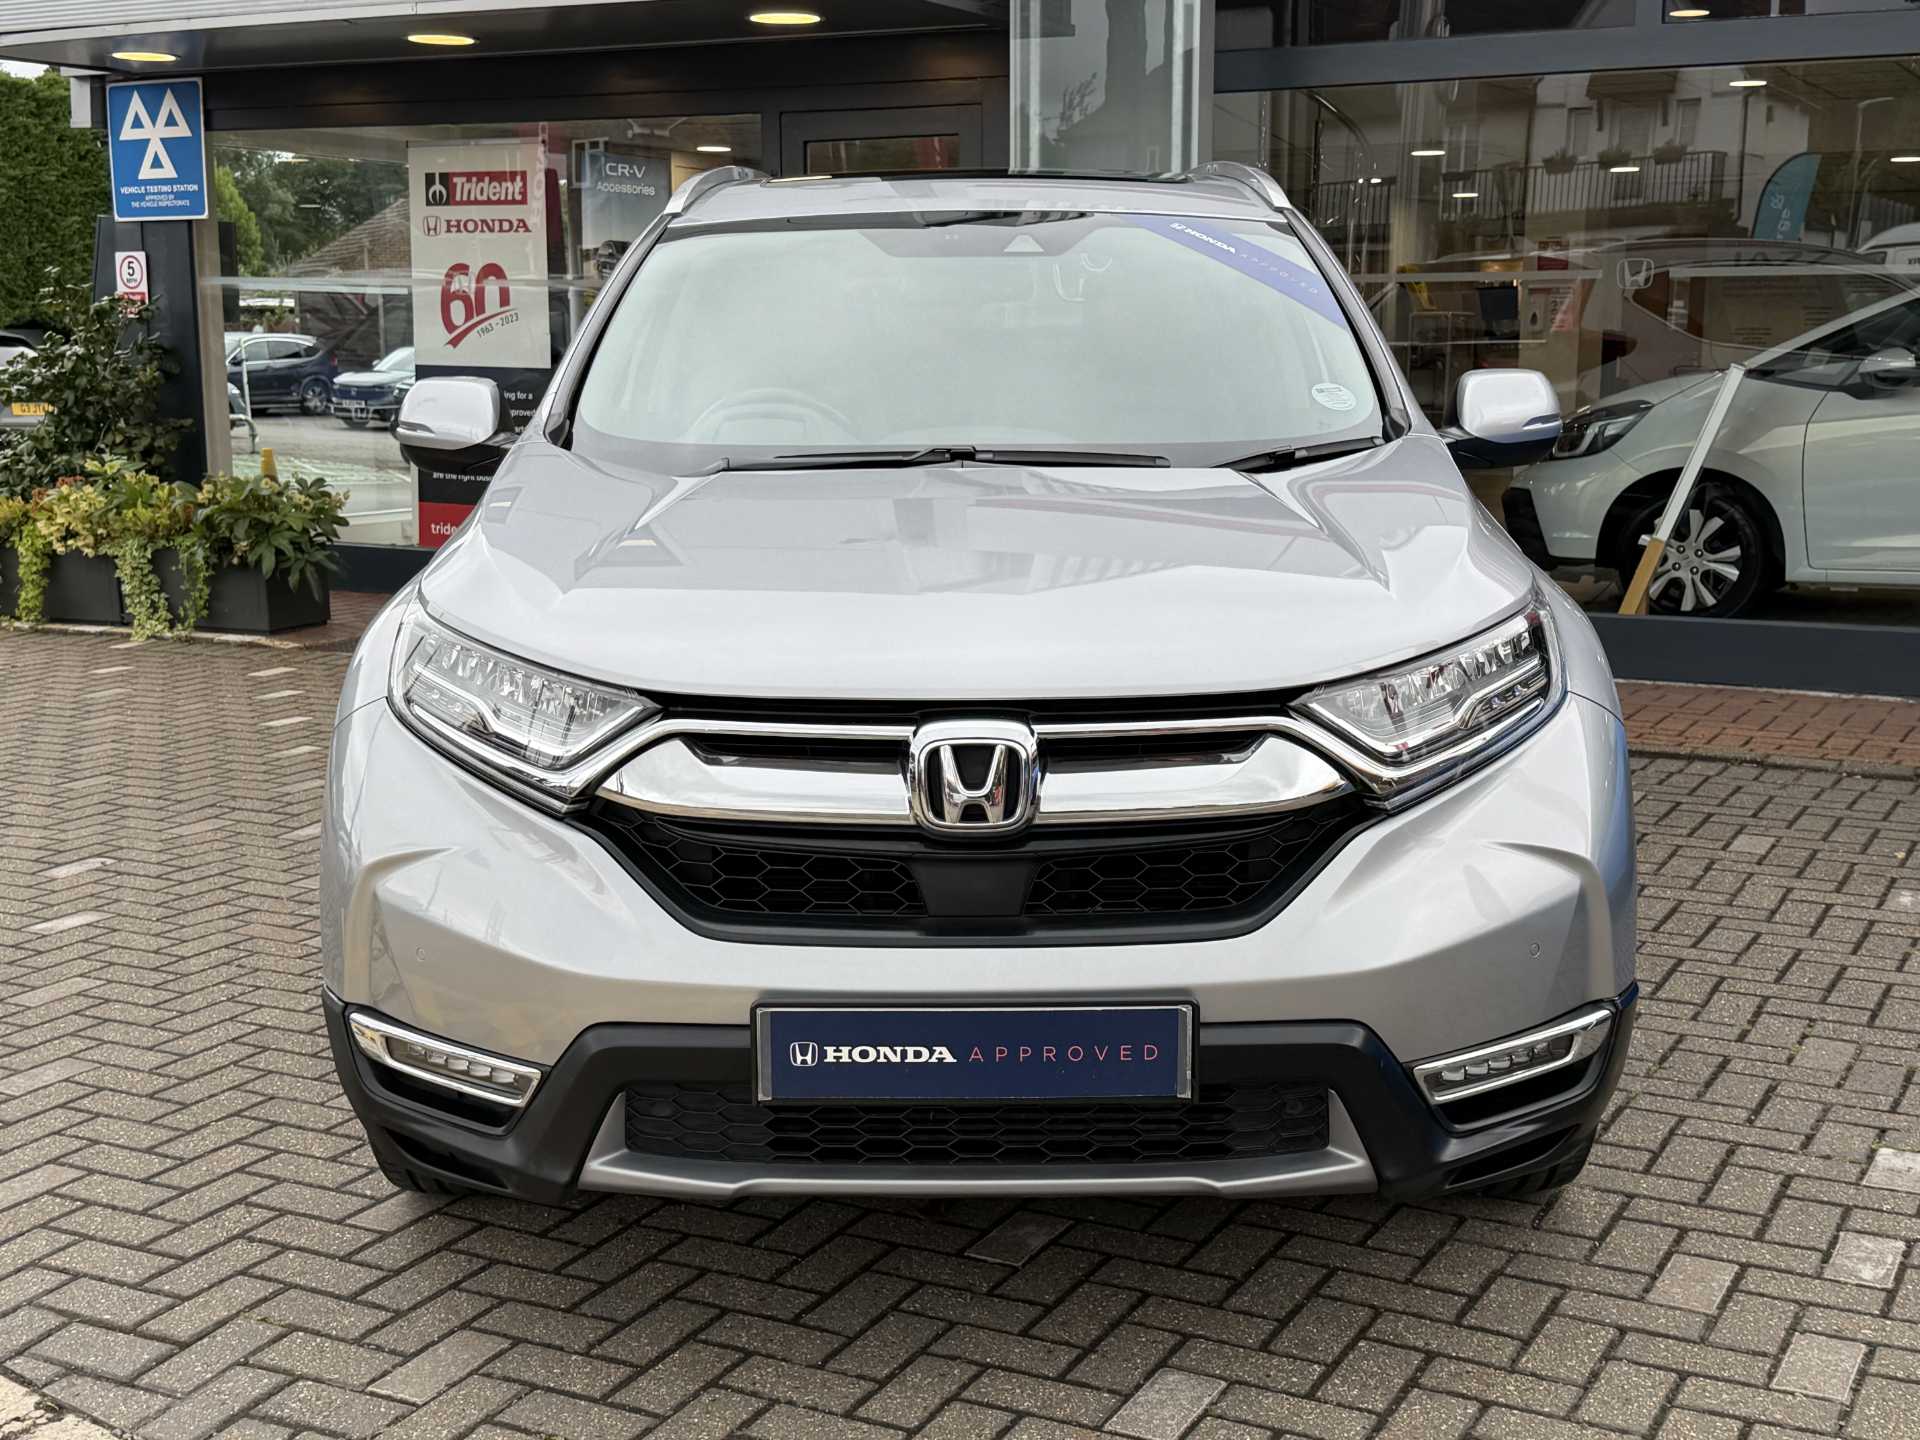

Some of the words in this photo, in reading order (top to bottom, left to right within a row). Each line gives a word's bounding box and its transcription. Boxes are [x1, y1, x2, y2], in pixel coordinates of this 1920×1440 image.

[120, 185, 145, 194] VEHICLE
[146, 184, 172, 193] TESTING
[173, 183, 199, 192] STATION
[452, 174, 524, 202] Trident
[596, 182, 656, 196] Accessories
[444, 217, 532, 234] HONDA
[1183, 228, 1236, 255] HONDA
[127, 260, 135, 277] 5
[440, 262, 511, 335] 60
[823, 1045, 957, 1064] HONDA
[968, 1044, 1160, 1063] APPROVED
